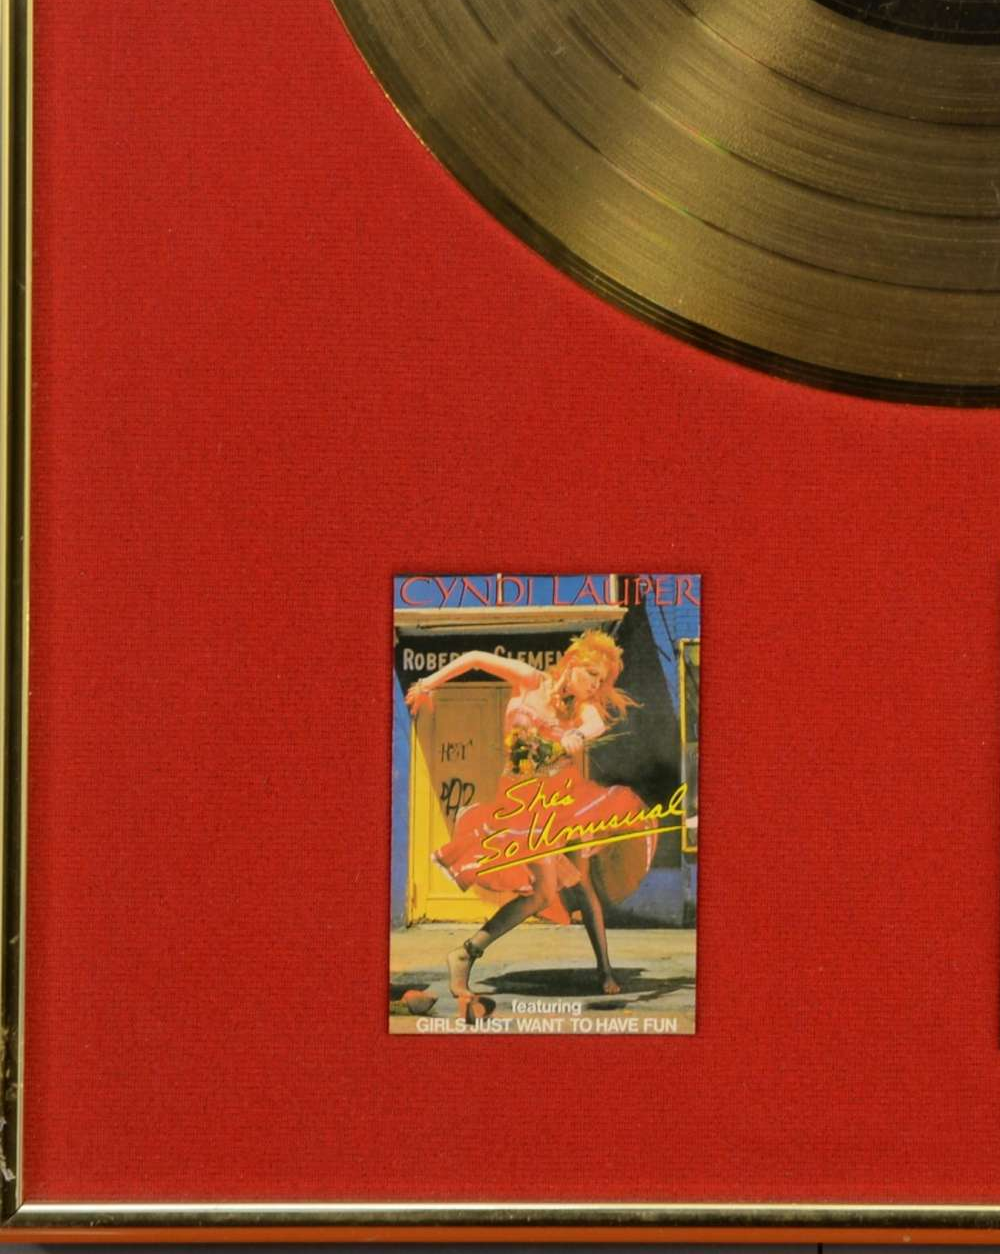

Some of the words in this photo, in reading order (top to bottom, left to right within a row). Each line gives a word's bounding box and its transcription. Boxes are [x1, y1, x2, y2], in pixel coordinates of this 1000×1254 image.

[400, 576, 535, 609] CYNDI
[552, 576, 701, 606] LAUPER
[494, 777, 575, 819] She's
[477, 829, 518, 865] So
[527, 783, 688, 850] Unusual
[511, 998, 582, 1015] featuring
[416, 1017, 466, 1034] GIRLS
[470, 1017, 513, 1033] JUST
[516, 1017, 564, 1033] WANT
[570, 1017, 592, 1033] TO
[596, 1017, 639, 1033] HAVE
[643, 1017, 678, 1033] FUN
